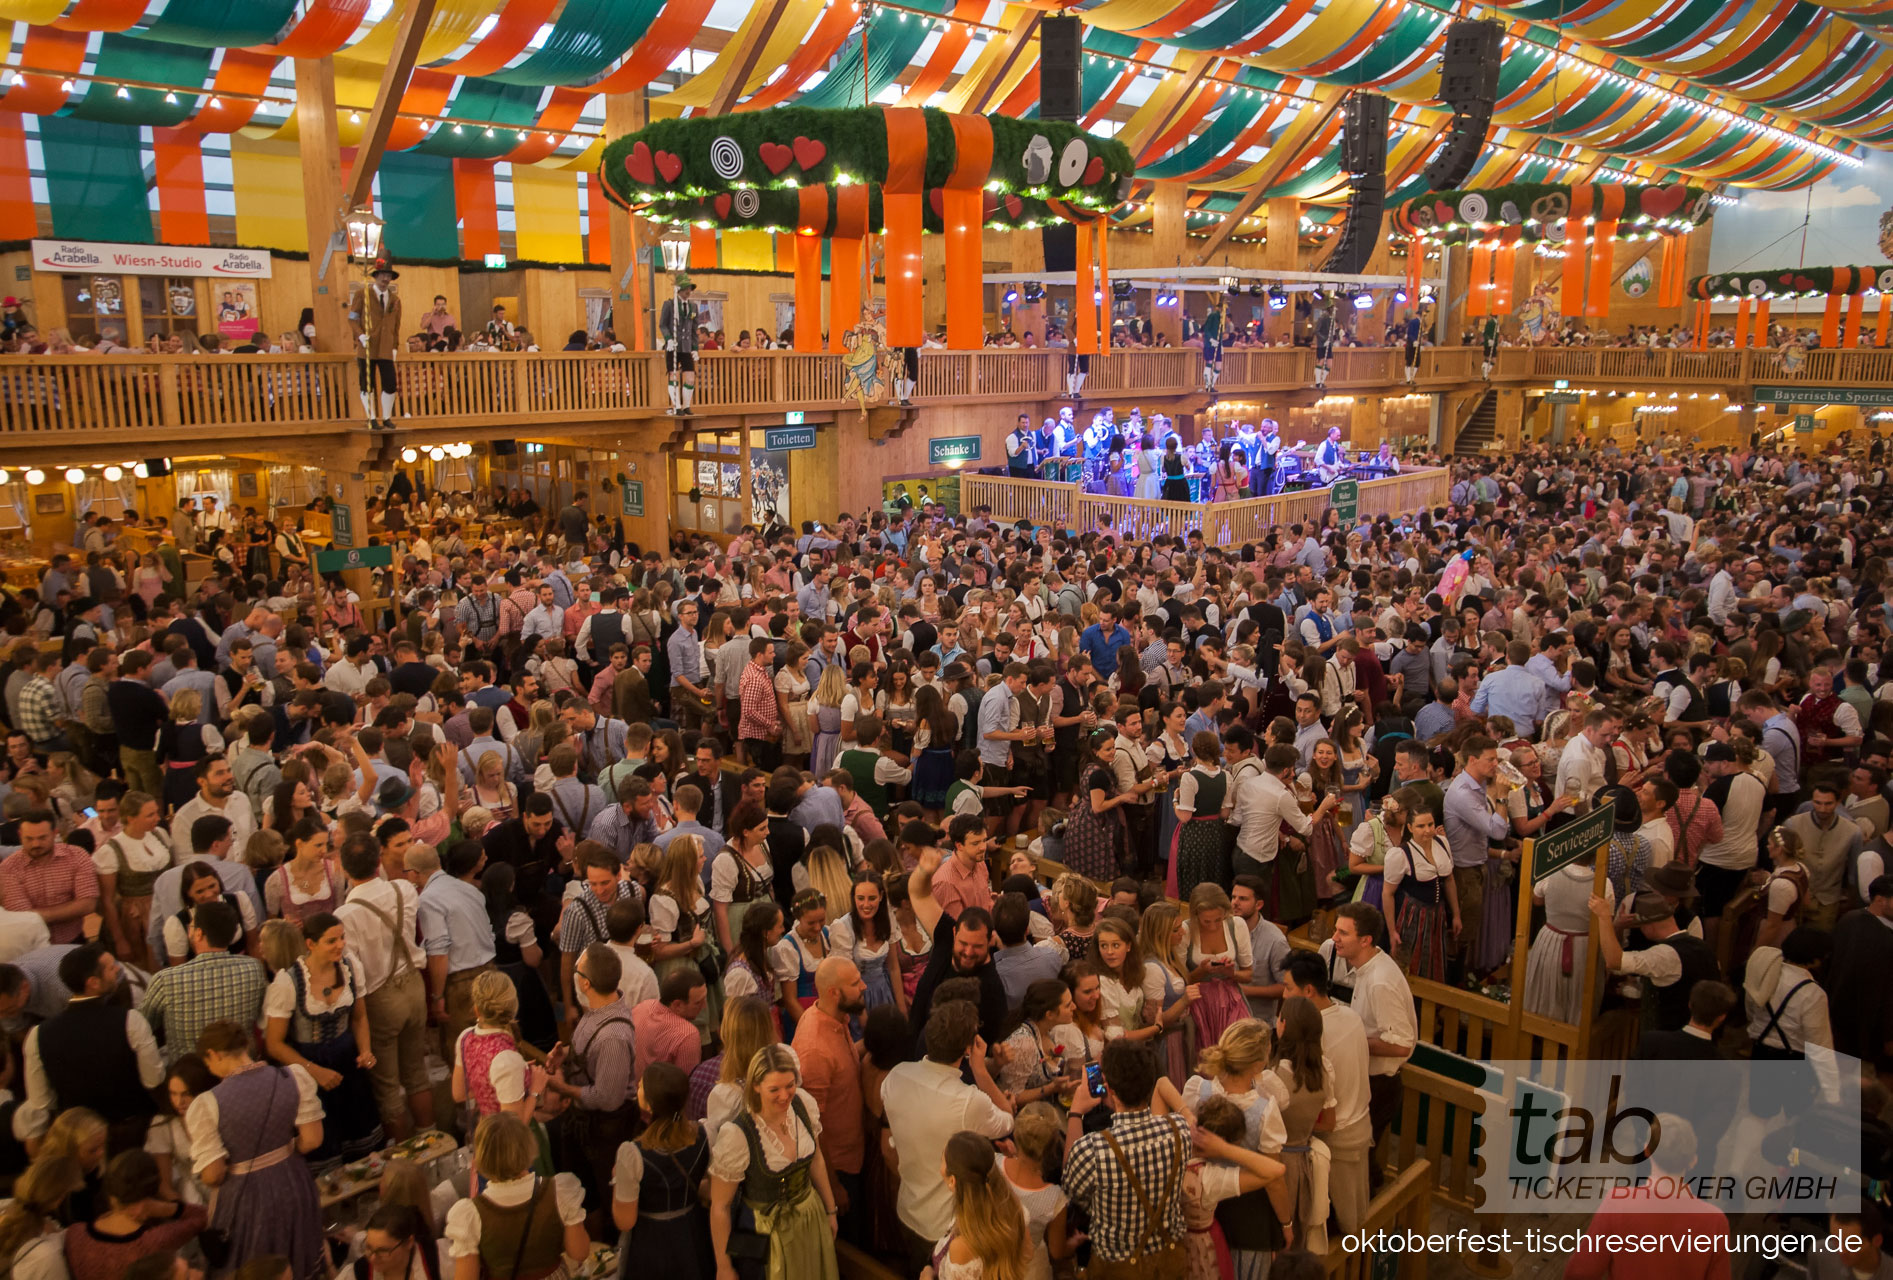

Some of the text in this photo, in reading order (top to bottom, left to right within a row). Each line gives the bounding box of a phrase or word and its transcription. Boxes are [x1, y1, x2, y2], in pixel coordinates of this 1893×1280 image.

[61, 245, 85, 254] Radio
[229, 251, 249, 260] Radio
[113, 254, 202, 269] Wiesn-Studio
[1774, 390, 1841, 402] Bayerische
[1799, 419, 1810, 428] 10
[770, 433, 811, 446] Toiletten
[934, 442, 969, 457] Schänke
[629, 490, 637, 504] 11
[338, 515, 346, 531] 11
[1546, 819, 1606, 862] Servicegang
